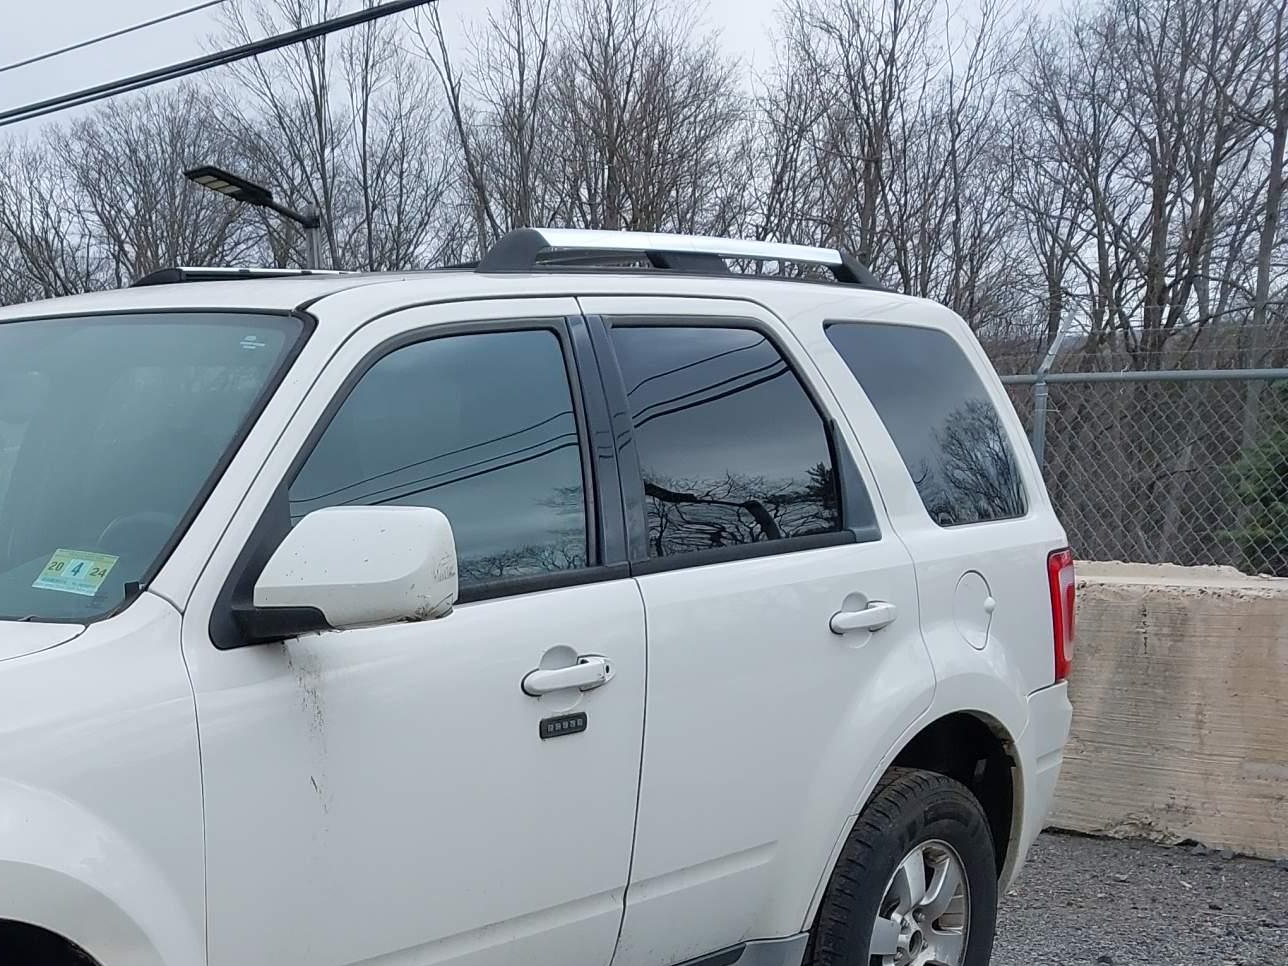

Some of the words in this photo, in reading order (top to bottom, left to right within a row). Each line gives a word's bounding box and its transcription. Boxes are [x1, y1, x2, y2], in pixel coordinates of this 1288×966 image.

[48, 561, 65, 572] 20
[72, 562, 84, 577] 4
[89, 567, 108, 578] 24
